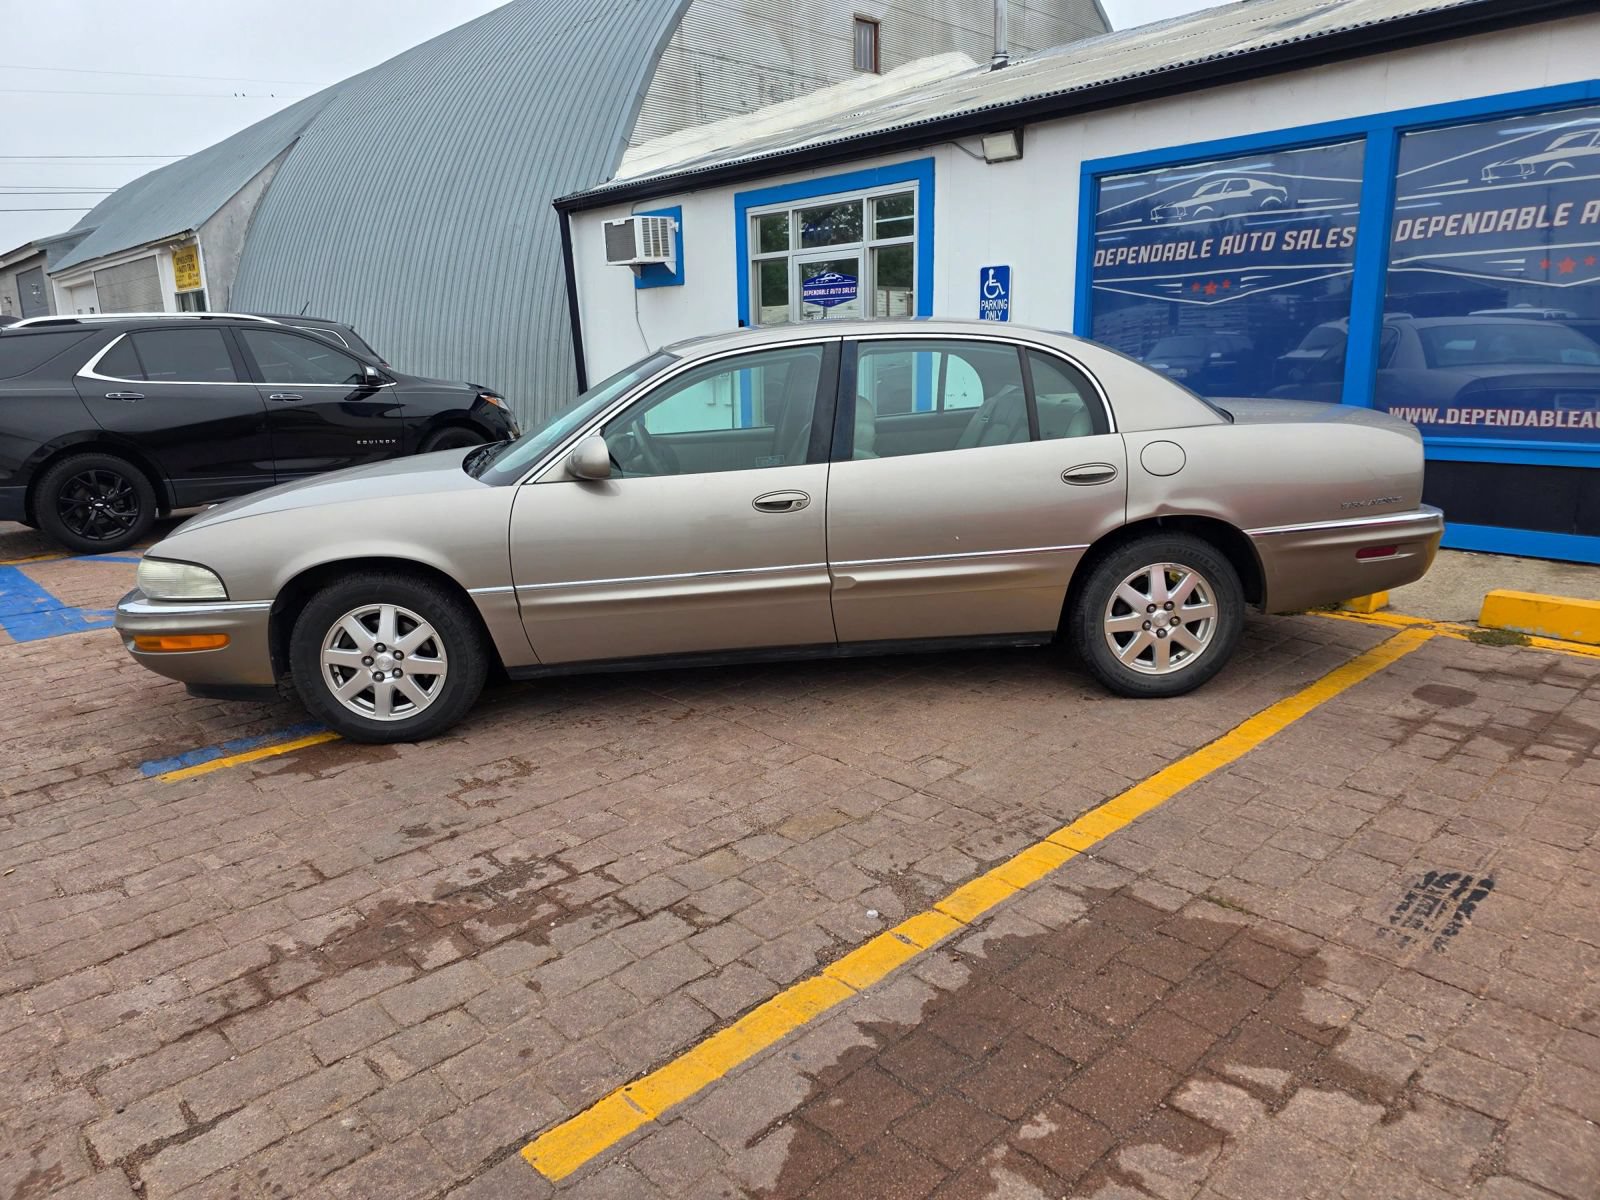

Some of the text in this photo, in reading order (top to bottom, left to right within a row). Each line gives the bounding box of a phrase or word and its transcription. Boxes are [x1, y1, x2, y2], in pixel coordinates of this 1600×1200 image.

[1394, 202, 1574, 242] DEPENDABLE
[1093, 226, 1357, 267] DEPENDABLE AUTO SALES
[803, 286, 856, 297] DEPENDABLE AUTO SALES
[981, 298, 1008, 311] PARKING
[985, 310, 1003, 321] ONLY
